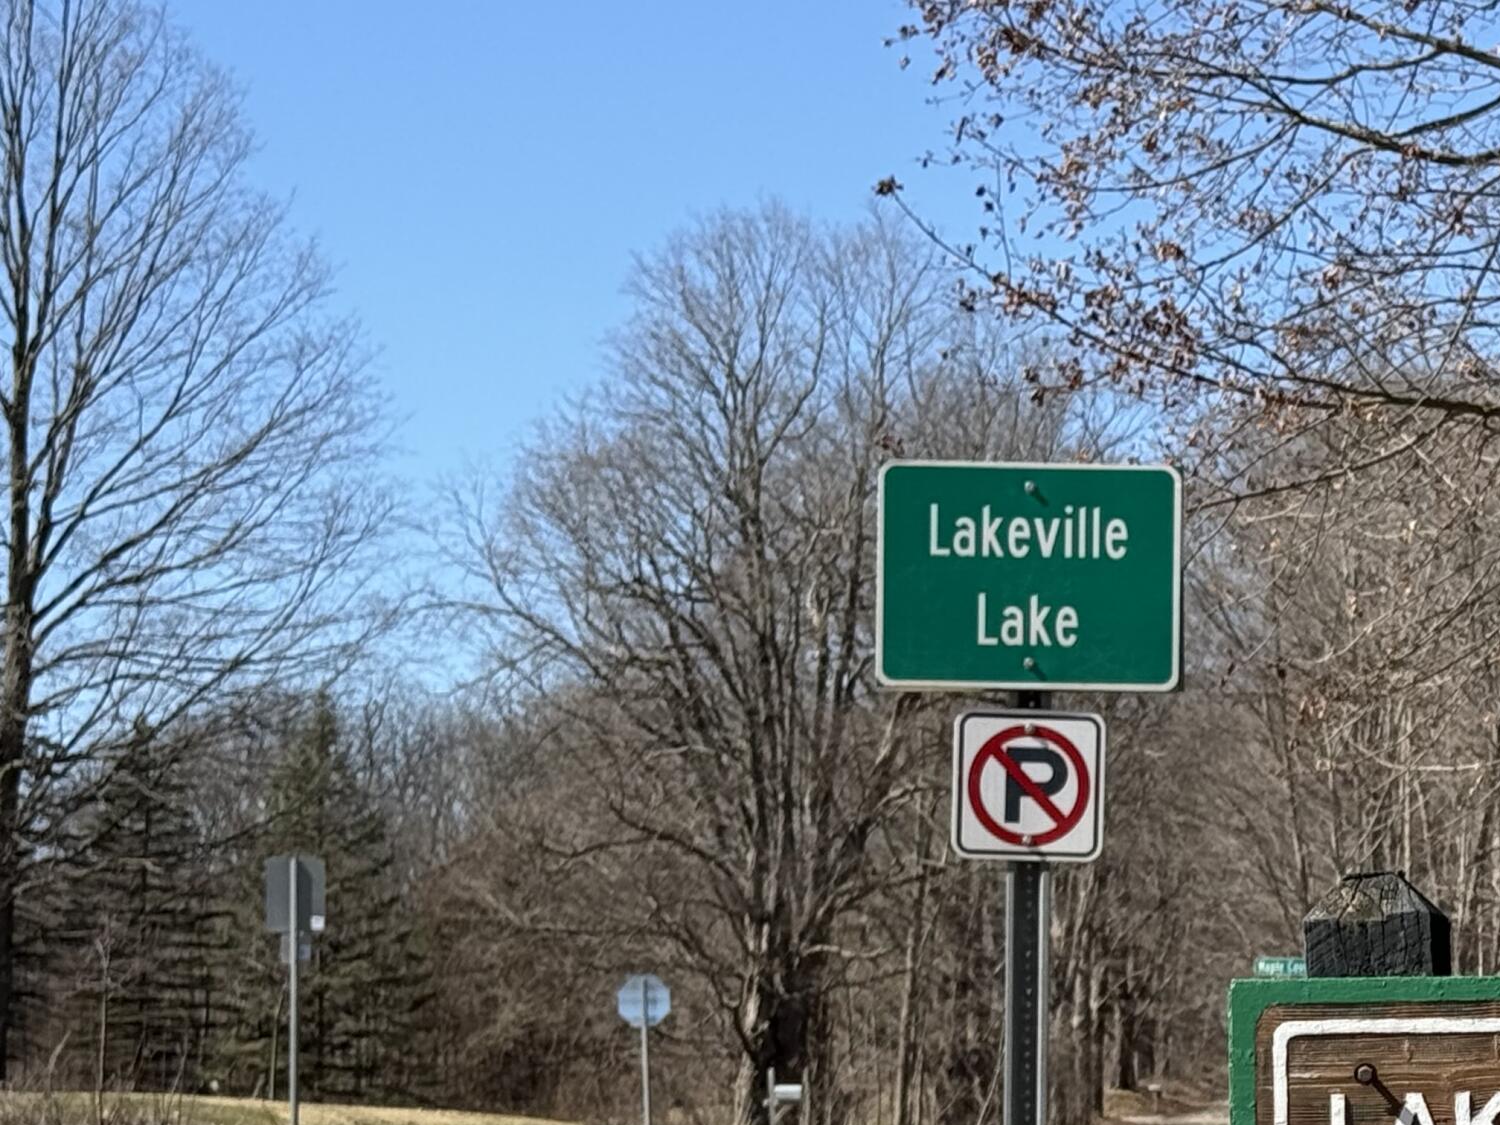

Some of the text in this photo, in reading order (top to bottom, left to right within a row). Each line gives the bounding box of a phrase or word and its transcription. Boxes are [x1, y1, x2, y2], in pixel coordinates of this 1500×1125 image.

[929, 503, 1128, 560] Lakeville
[977, 592, 1079, 648] Lake
[1004, 746, 1068, 824] P
